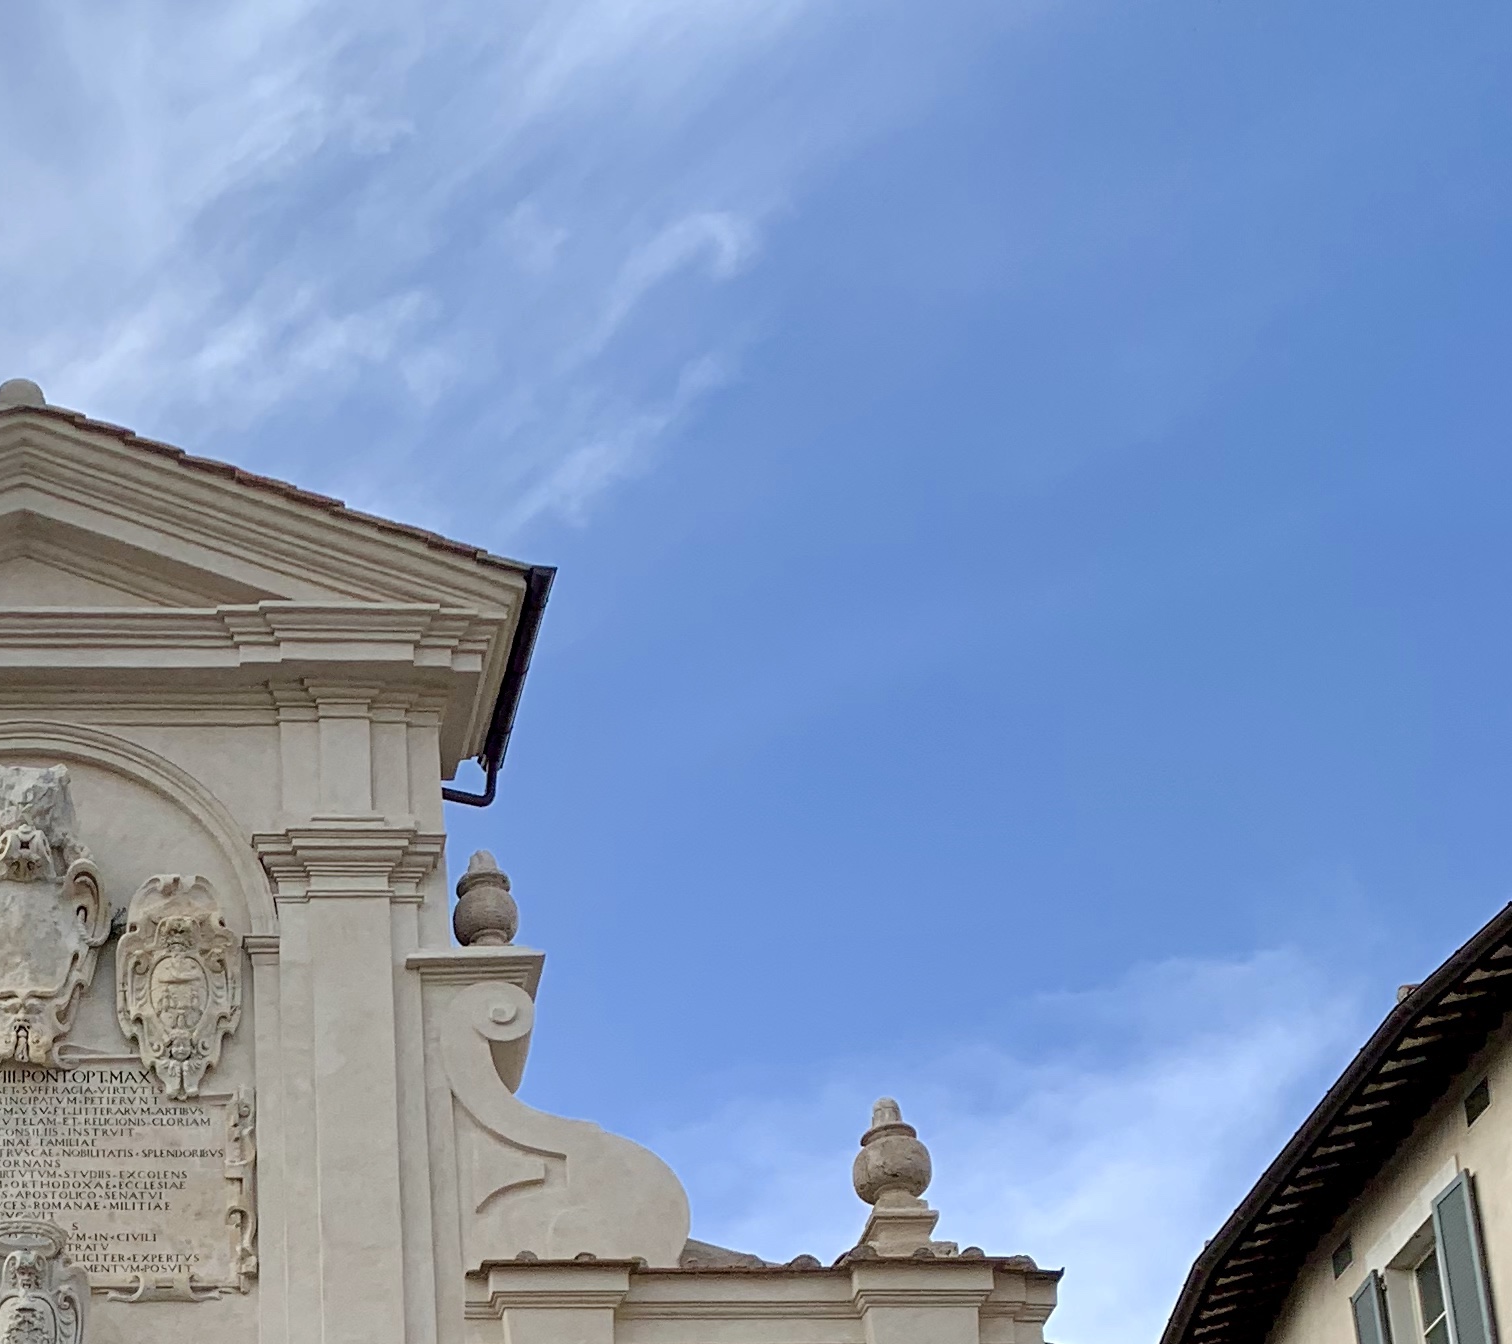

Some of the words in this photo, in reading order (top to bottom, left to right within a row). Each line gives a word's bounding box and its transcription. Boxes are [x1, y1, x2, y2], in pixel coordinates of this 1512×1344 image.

[68, 1128, 136, 1137] INSTRVIT
[40, 1138, 97, 1147] FAMILIAE
[62, 1149, 134, 1158] NOBILITATIS
[141, 1149, 224, 1158] SPLENDORIBVS
[64, 1169, 111, 1179] STVDIIS
[119, 1169, 188, 1179] EXCOLENS
[11, 1180, 111, 1190] ORTHODOXAE
[118, 1180, 186, 1190] ECCLESIAE
[15, 1190, 96, 1200] APOSTOLICO
[104, 1190, 163, 1200] SENATVI
[34, 1201, 101, 1210] ROMANAE
[110, 1201, 171, 1210] MILITIAE
[94, 1232, 109, 1241] IN
[116, 1232, 157, 1241] CIVILI
[133, 1253, 200, 1262] EXPERTVS
[144, 1264, 193, 1273] POSVIT
